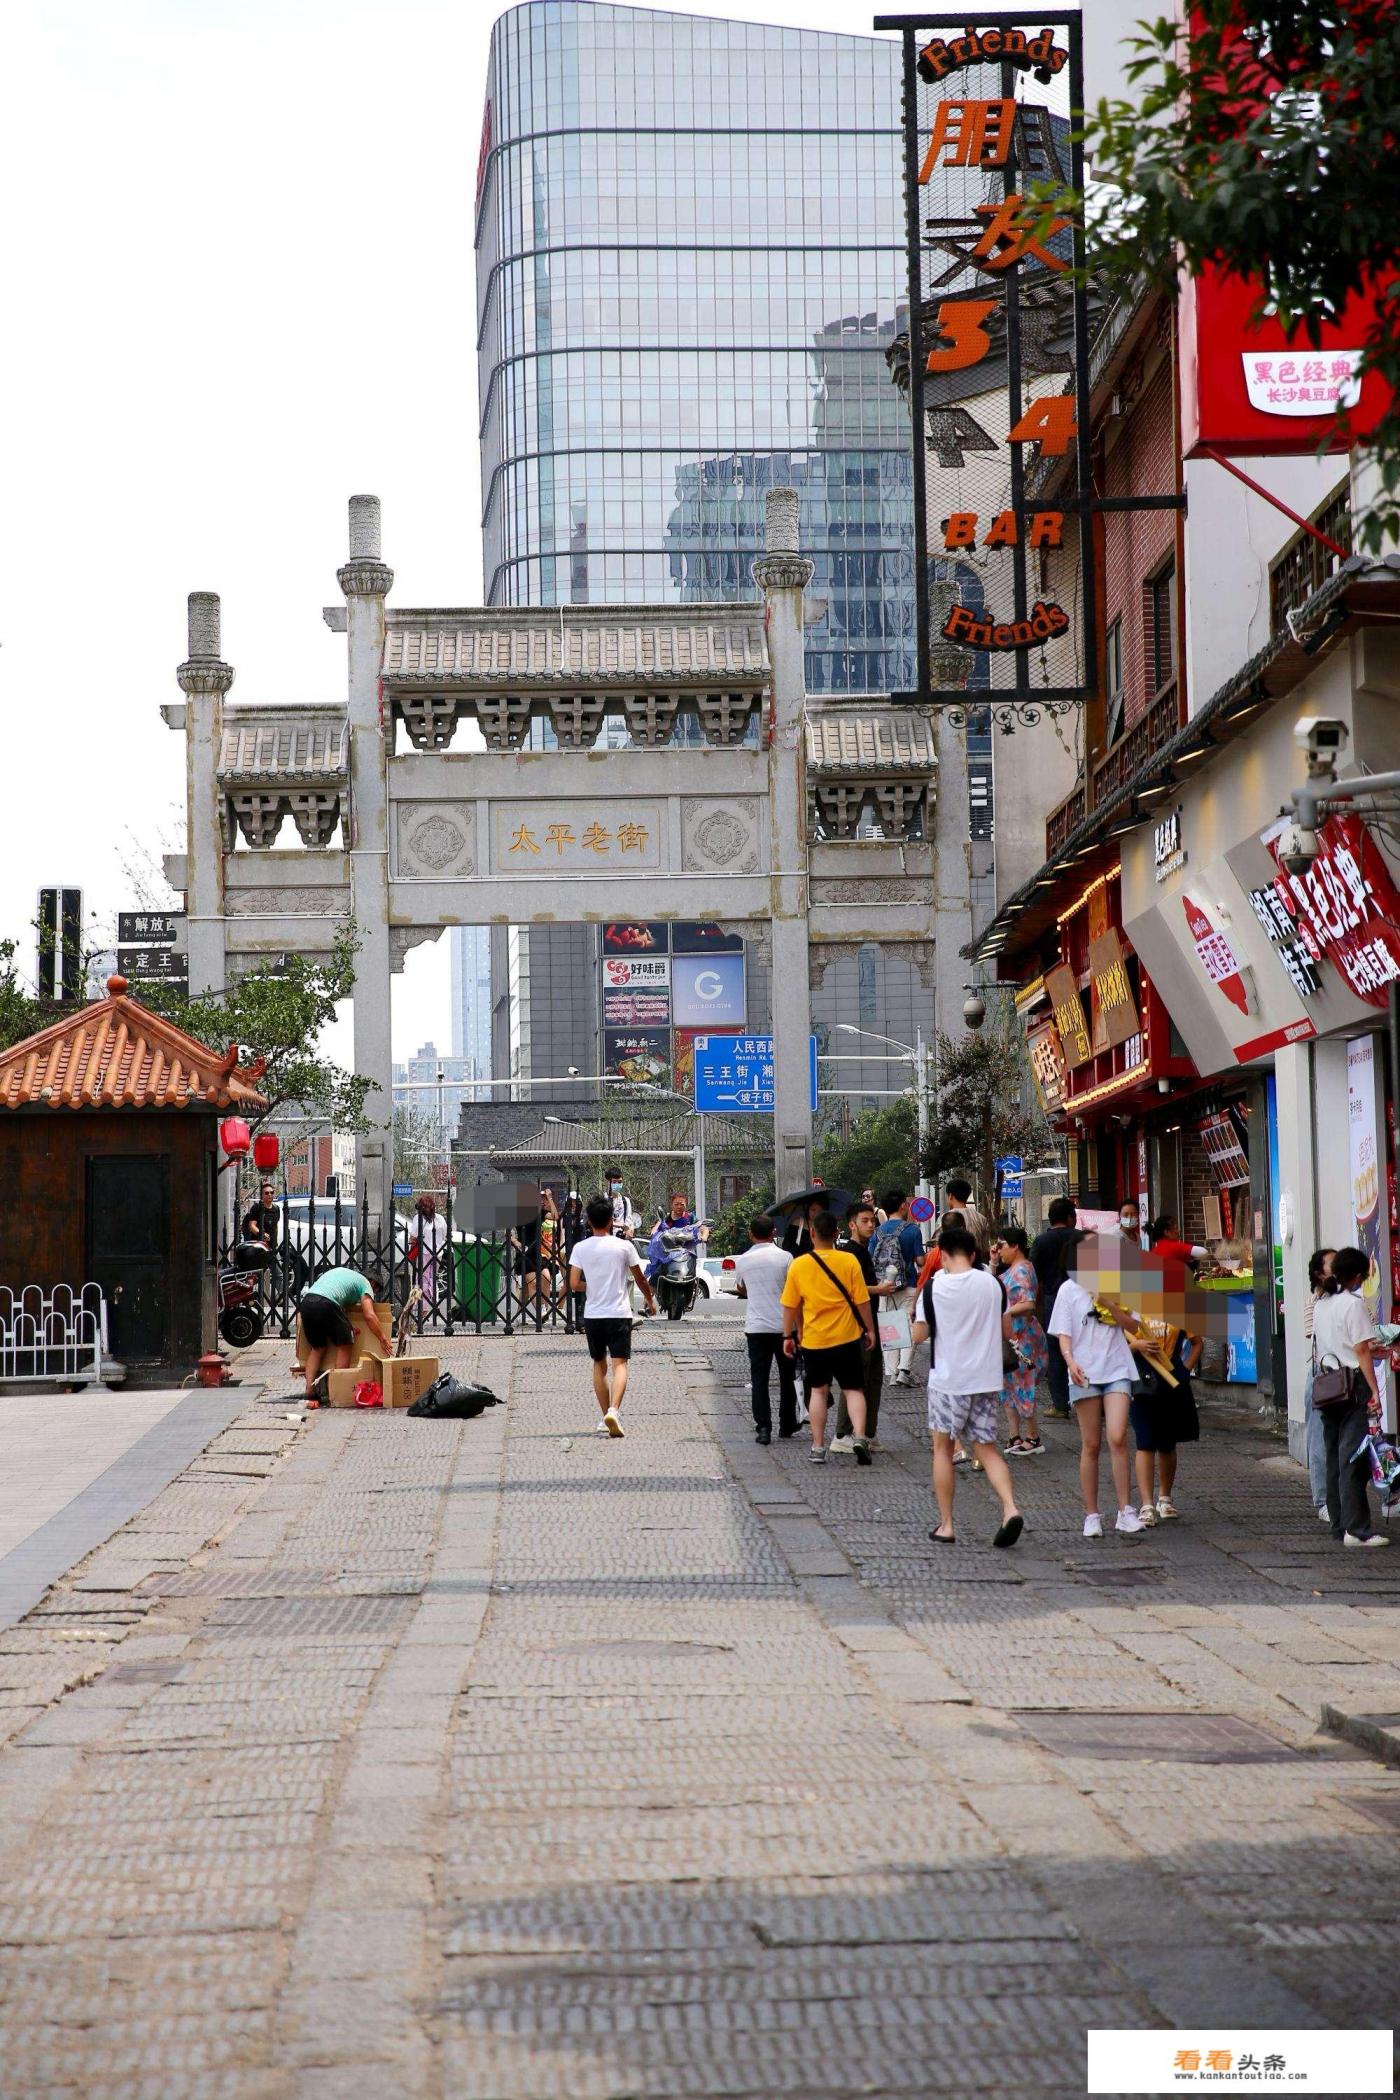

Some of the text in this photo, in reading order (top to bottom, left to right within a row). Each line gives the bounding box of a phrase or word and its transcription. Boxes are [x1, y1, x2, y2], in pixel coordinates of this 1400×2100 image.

[918, 25, 1069, 79] Friends
[1253, 359, 1352, 385] 黑色经典
[1266, 387, 1342, 403] 长沙臭豆腐
[944, 510, 1063, 549] BAR
[943, 602, 1070, 651] Friends
[508, 821, 650, 857] 太平老街
[1288, 842, 1385, 948] 黑色经典
[124, 917, 176, 931] 东 解放西
[1249, 883, 1296, 942] 湖南
[631, 963, 665, 974] 好味爵
[1278, 938, 1317, 997] 特产
[695, 971, 723, 1000] G
[703, 1064, 774, 1078] 三王街 湘
[740, 1092, 773, 1103] 坡子街
